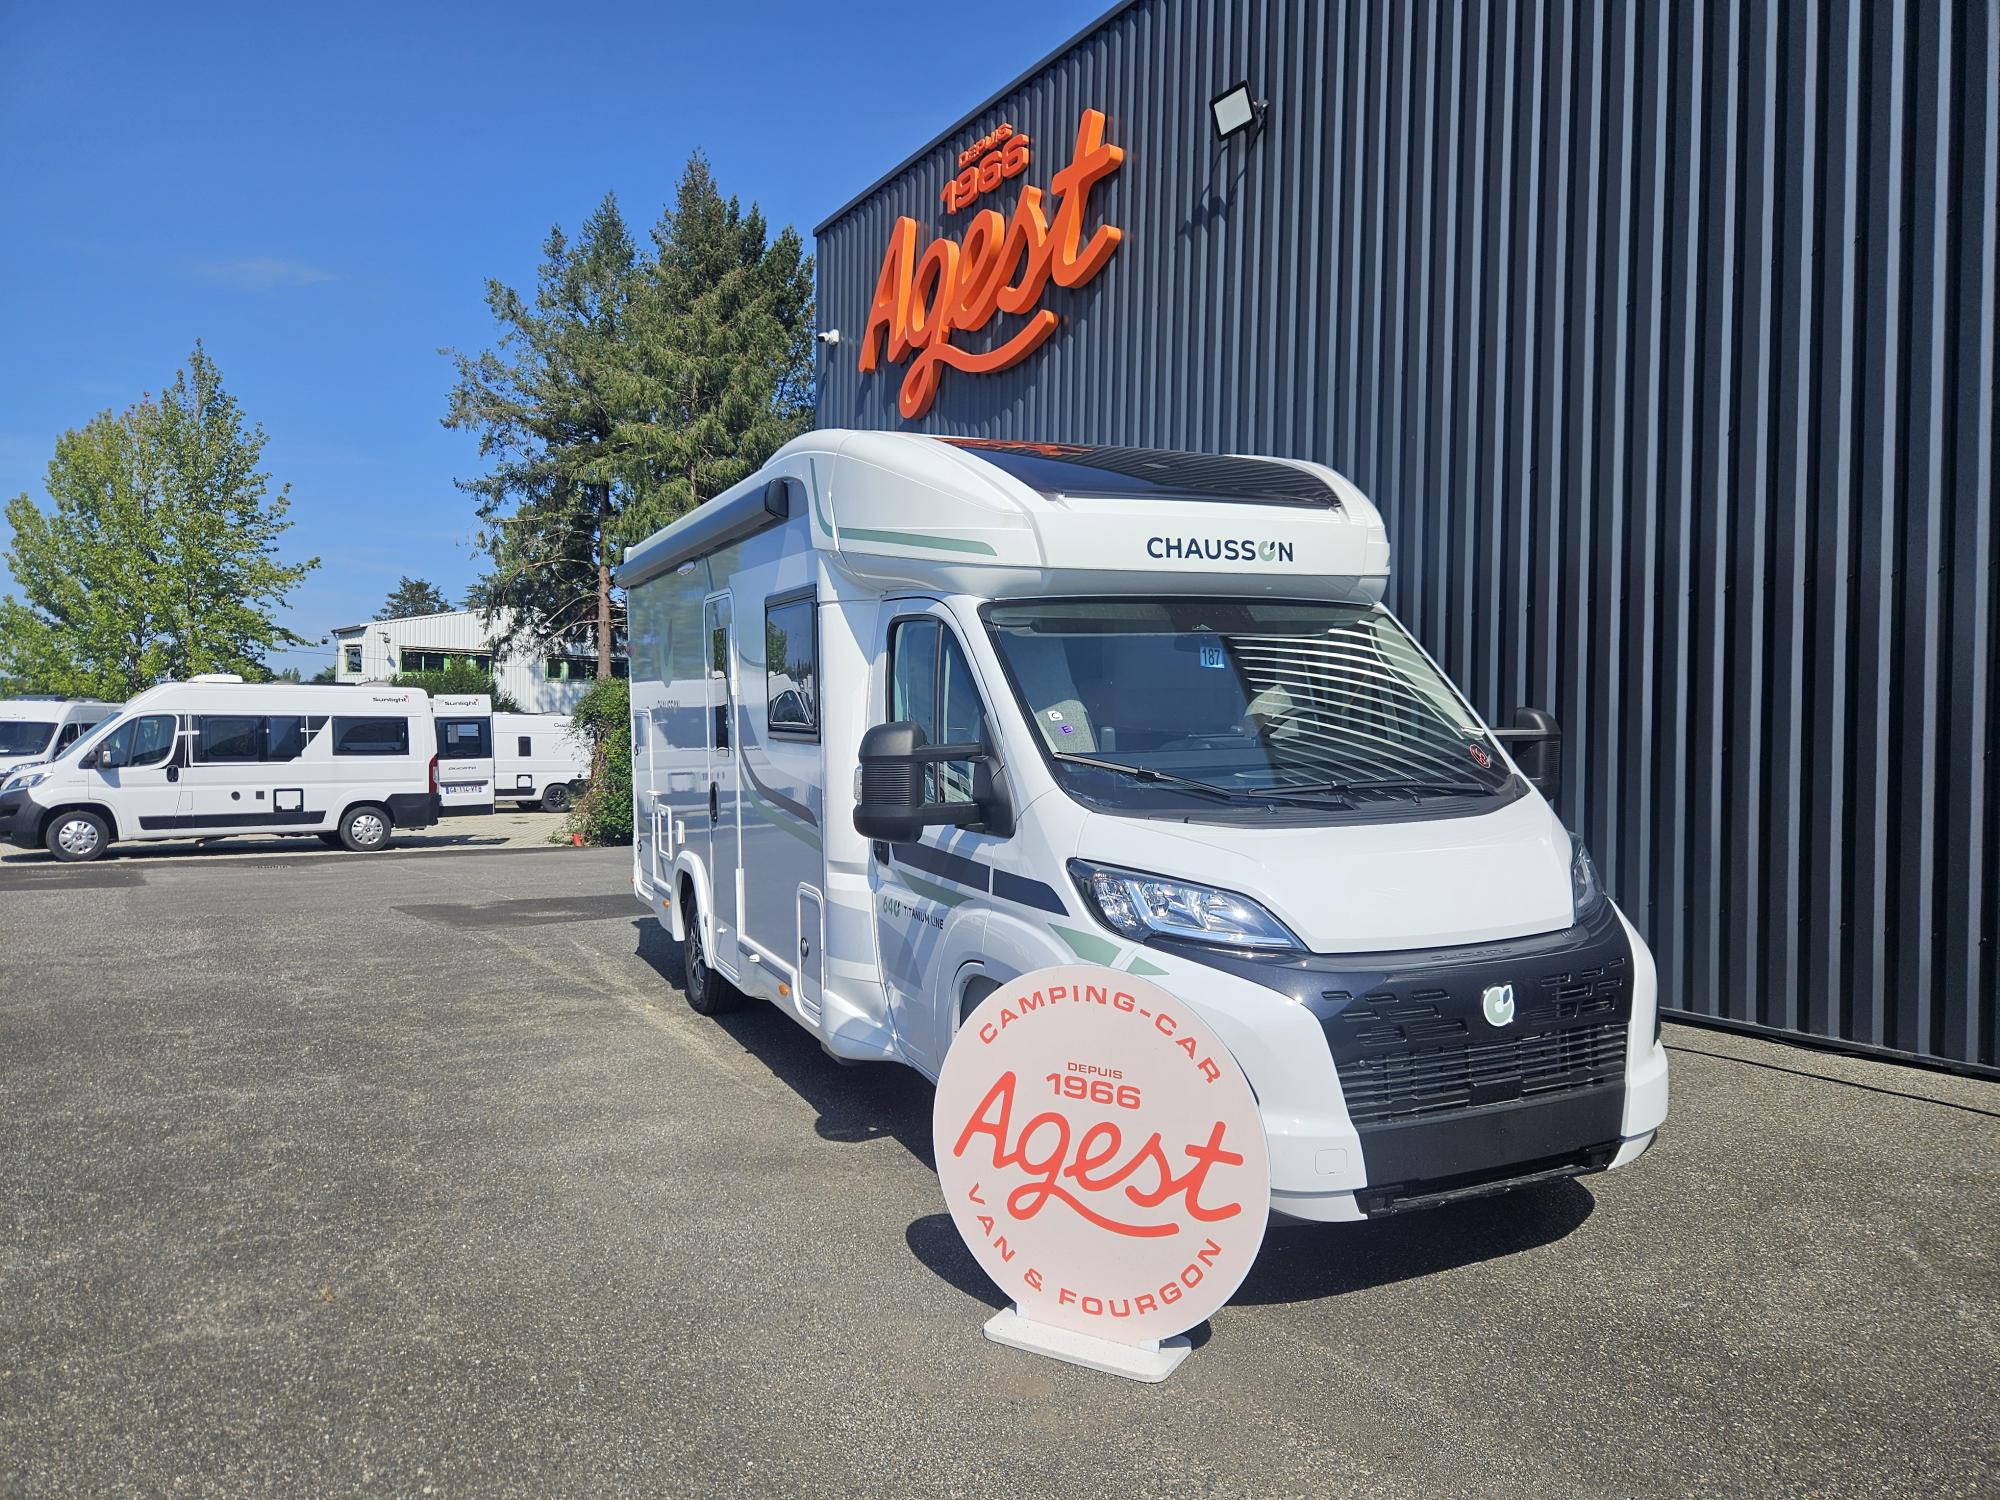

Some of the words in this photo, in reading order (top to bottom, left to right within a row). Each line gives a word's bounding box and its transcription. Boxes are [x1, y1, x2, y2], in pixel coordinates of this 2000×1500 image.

[959, 123, 1013, 168] DEPUIS
[940, 134, 1029, 214] 1966
[858, 108, 1124, 420] Agest
[1146, 536, 1294, 562] CHAUSSON
[1202, 647, 1220, 665] 187
[372, 696, 407, 704] Sunlight
[903, 905, 930, 924] TITANIUM
[930, 914, 944, 930] LINE
[979, 984, 1222, 1085] CAMPING-CAR
[1045, 1072, 1142, 1110] 1966
[1067, 1062, 1123, 1080] DEPUIS
[953, 1071, 1244, 1238] Agest
[968, 1183, 1017, 1263] VAN
[1023, 1267, 1045, 1293] &
[1058, 1238, 1223, 1318] FOURGON
